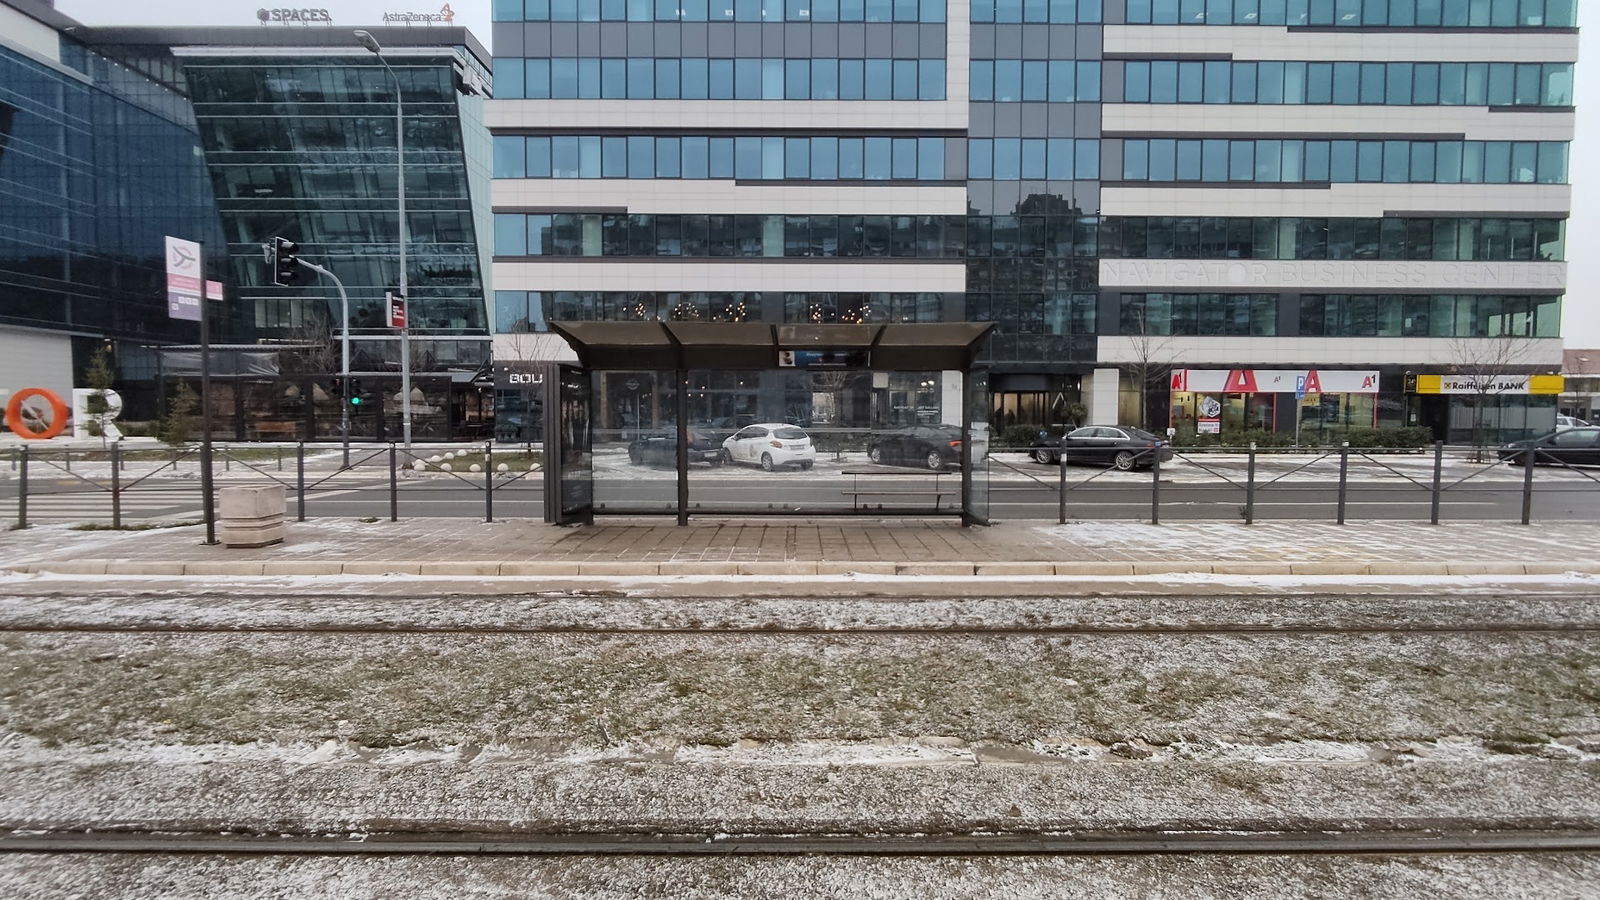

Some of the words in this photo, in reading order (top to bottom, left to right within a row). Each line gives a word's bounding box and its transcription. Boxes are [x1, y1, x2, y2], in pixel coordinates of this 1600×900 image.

[382, 12, 442, 22] AstraZeneca
[1103, 261, 1269, 284] NAVIGATOR
[1280, 262, 1426, 285] BUSINESS
[1442, 263, 1563, 286] CENTER
[1361, 374, 1376, 389] A1
[1498, 382, 1524, 390] BANK
